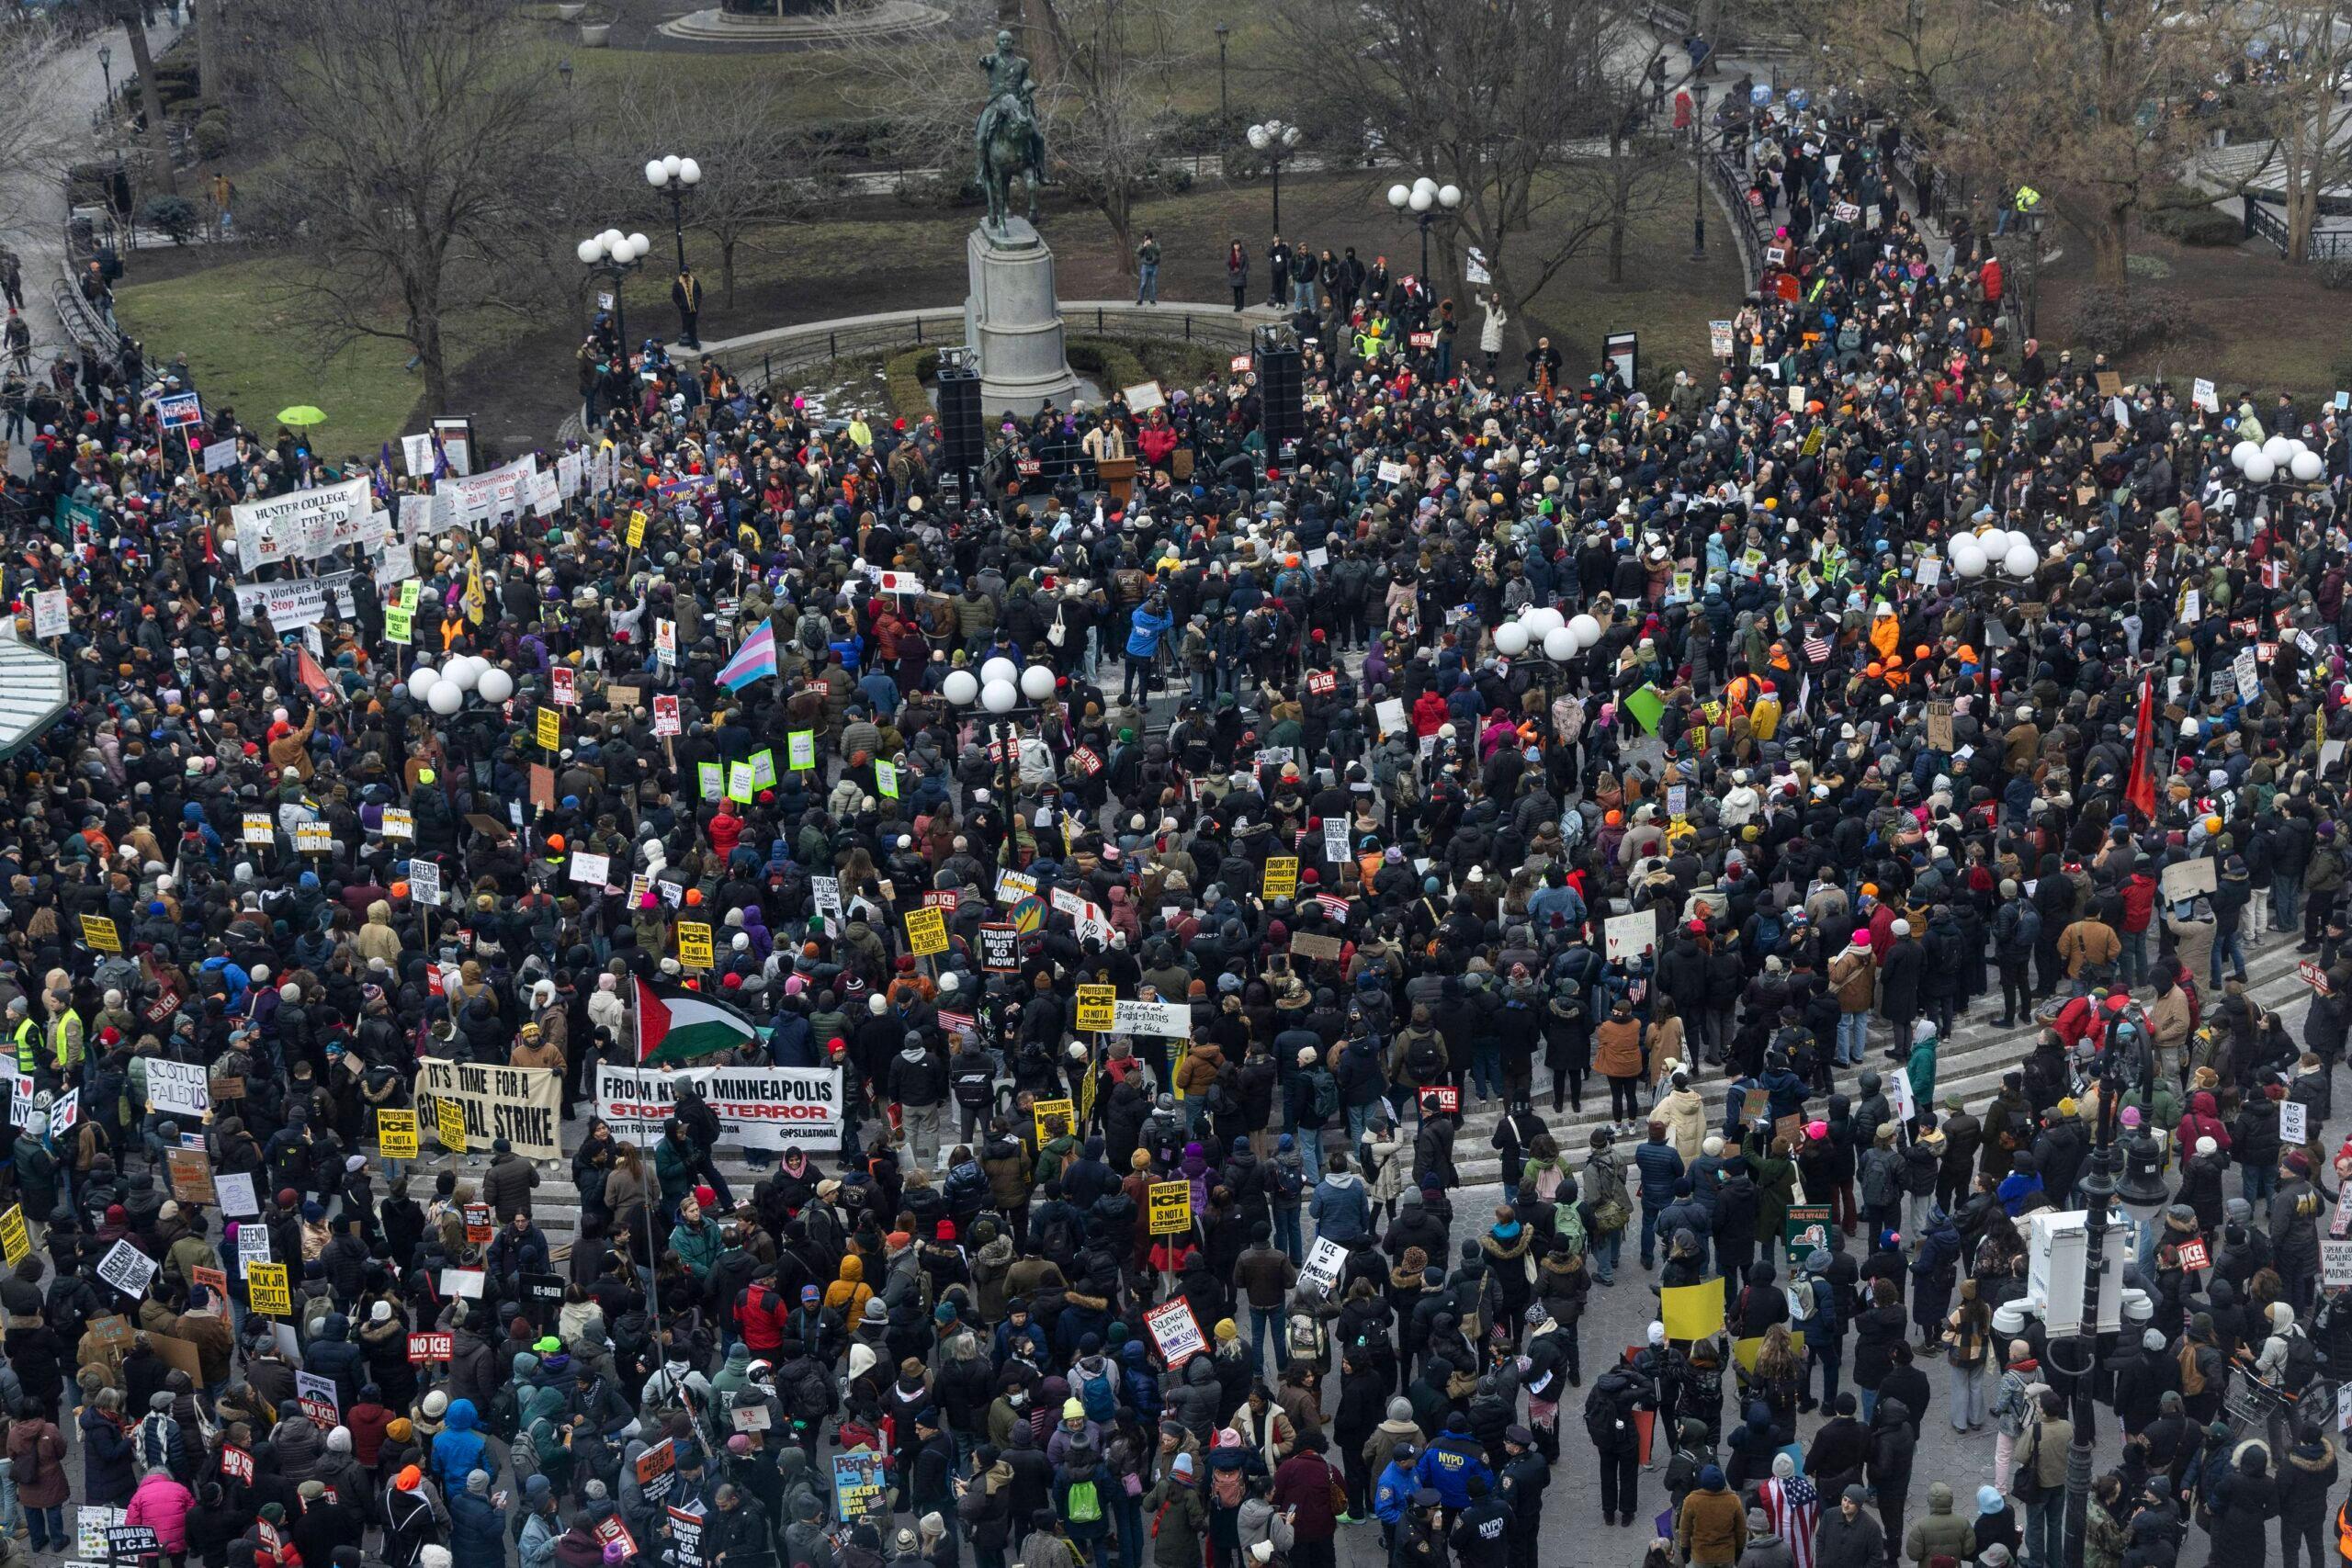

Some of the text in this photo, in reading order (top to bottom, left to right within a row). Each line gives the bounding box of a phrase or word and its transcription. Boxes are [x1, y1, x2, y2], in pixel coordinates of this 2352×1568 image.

[469, 468, 528, 491] Committee to
[255, 491, 348, 521] HUNTER COLLEGE
[330, 510, 345, 522] TO
[269, 584, 311, 600] Workers
[271, 600, 295, 613] Stop
[388, 612, 408, 624] ABOLISH
[391, 623, 402, 632] ICE!
[1309, 674, 1335, 689] NO ICE!
[657, 724, 679, 733] STRIKE
[990, 745, 1001, 757] NO
[1076, 746, 1101, 772] NO ICE!
[243, 813, 272, 824] AMAZON
[383, 808, 412, 818] AMAZON
[298, 822, 331, 831] AMAZON
[381, 821, 413, 838] UNFAIR
[1326, 819, 1347, 831] DEFEND
[243, 828, 275, 843] UNFAIR
[298, 836, 333, 851] UNFAIR
[412, 861, 437, 876] DEFEND
[1268, 858, 1296, 869] DROP THE
[1004, 870, 1037, 886] AMAZON
[1267, 869, 1288, 877] CHARGES
[813, 878, 838, 887] NO ONE
[1264, 883, 1295, 893] ACTIVISTS!
[924, 893, 955, 906] NO ICE!
[907, 908, 937, 919] FIGHT
[83, 916, 98, 926] DROP
[1082, 920, 1098, 935] NO
[1634, 916, 1649, 927] ALL
[679, 923, 710, 934] PROTESTING
[928, 929, 944, 939] EVILS
[981, 929, 1017, 940] TRUMP
[680, 932, 710, 944] ICE
[985, 939, 1014, 949] MUST
[684, 945, 707, 955] IS NOT A
[992, 948, 1008, 957] GO
[988, 956, 1015, 966] NOW!
[2301, 964, 2313, 978] NO
[1080, 986, 1114, 995] PROTESTING
[147, 993, 178, 1021] NO ICE!
[1080, 996, 1114, 1007] ICE
[1117, 1002, 1135, 1010] Dad
[1083, 1010, 1108, 1019] IS NOT A
[15, 1077, 20, 1096] I
[428, 1063, 529, 1100] IT'S TIME FOR A
[603, 1077, 833, 1101] FROM MINNEAPOLIS
[149, 1082, 209, 1111] FAILED US
[1438, 1090, 1456, 1104] ICE!
[13, 1103, 30, 1123] NY
[610, 1103, 828, 1120] STOP TERROR
[1035, 1101, 1071, 1112] PROTESTING
[2286, 1103, 2299, 1111] NO
[379, 1111, 413, 1121] PROTESTING
[2286, 1115, 2300, 1124] NO
[379, 1121, 414, 1133] ICE
[493, 1102, 554, 1146] STRIKE
[386, 1135, 412, 1145] IS NOT A
[780, 1128, 838, 1139] @PSLNATIONAL
[1150, 1183, 1188, 1195] PROTESTING
[1151, 1193, 1188, 1207] ICE
[1156, 1208, 1184, 1221] IS NOT A
[1151, 1217, 1188, 1227] CRIME!
[240, 1227, 266, 1241] DEFEND
[1320, 1241, 1338, 1258] ICE
[2324, 1246, 2343, 1254] SPEAK
[100, 1242, 130, 1277] DEFEND
[2324, 1254, 2352, 1262] AGAINS
[1304, 1261, 1336, 1283] AMERICAN
[2324, 1269, 2352, 1280] MADNE
[249, 1271, 285, 1288] MLK JR
[252, 1288, 287, 1303] SHUT IT
[533, 1286, 561, 1298] ICE=DEATH
[254, 1301, 288, 1309] DOWN!
[1147, 1298, 1182, 1320] PSC-CUNY
[1151, 1308, 1190, 1332] SOLIDARITY
[1163, 1323, 1184, 1337] WITH
[410, 1337, 450, 1353] NO ICE!
[1160, 1326, 1202, 1352] MINNESOTA
[300, 1402, 336, 1422] NO ICE!
[2339, 1402, 2350, 1414] OF
[224, 1450, 241, 1466] NO
[643, 1452, 671, 1471] MUST
[649, 1449, 662, 1461] ICE
[1438, 1451, 1464, 1466] NYPD
[840, 1484, 880, 1498] SEXIST
[842, 1497, 864, 1507] MAN
[842, 1506, 867, 1516] ALIVE
[258, 1521, 273, 1540] NO
[599, 1517, 621, 1538] NO
[670, 1517, 701, 1535] TRUMP
[1478, 1517, 1504, 1534] NYPD
[109, 1527, 154, 1540] ABOLISH
[673, 1529, 699, 1545] MUST
[116, 1538, 156, 1551] I.C.E.
[680, 1542, 695, 1554] GO
[678, 1551, 702, 1567] NOW!
